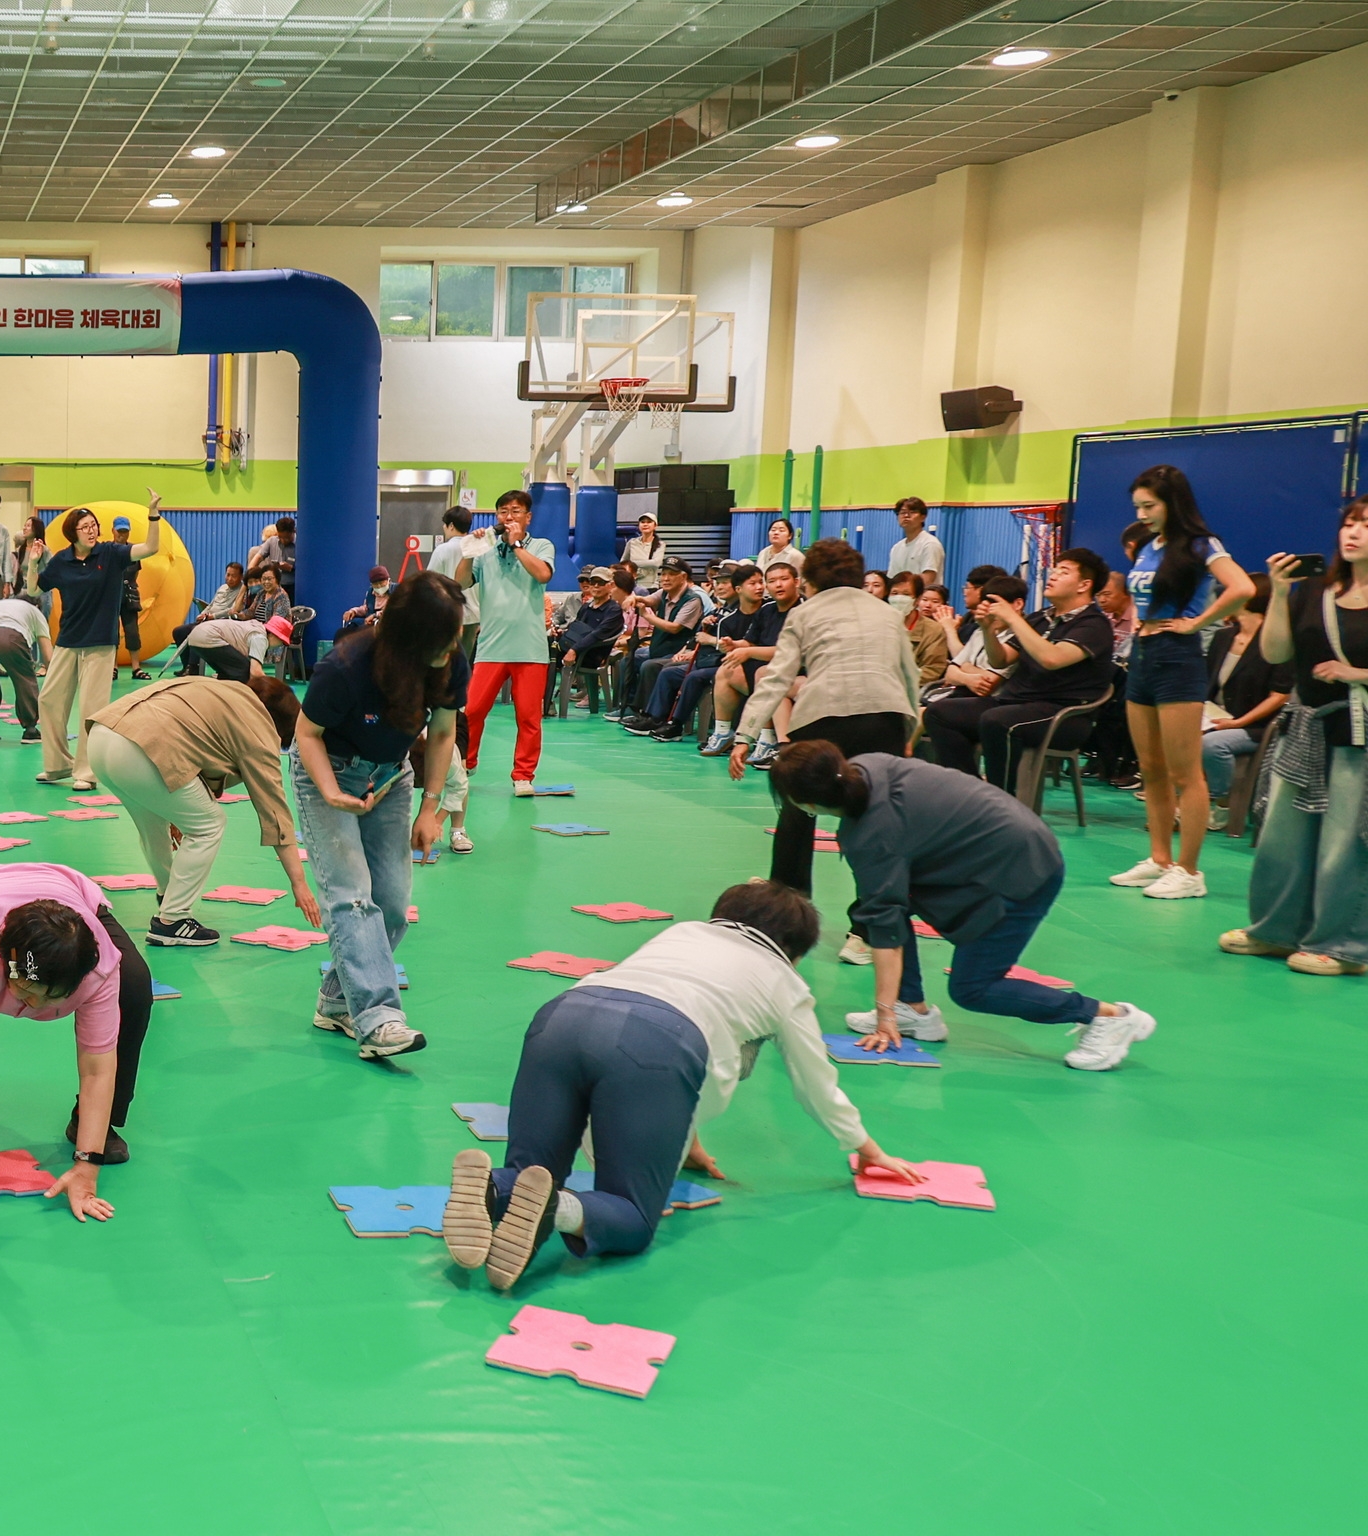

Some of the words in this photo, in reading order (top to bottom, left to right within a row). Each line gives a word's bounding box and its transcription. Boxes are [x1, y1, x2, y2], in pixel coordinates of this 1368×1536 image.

[13, 307, 74, 328] 한마음
[80, 308, 161, 329] 체육대회
[1127, 571, 1157, 593] 72
